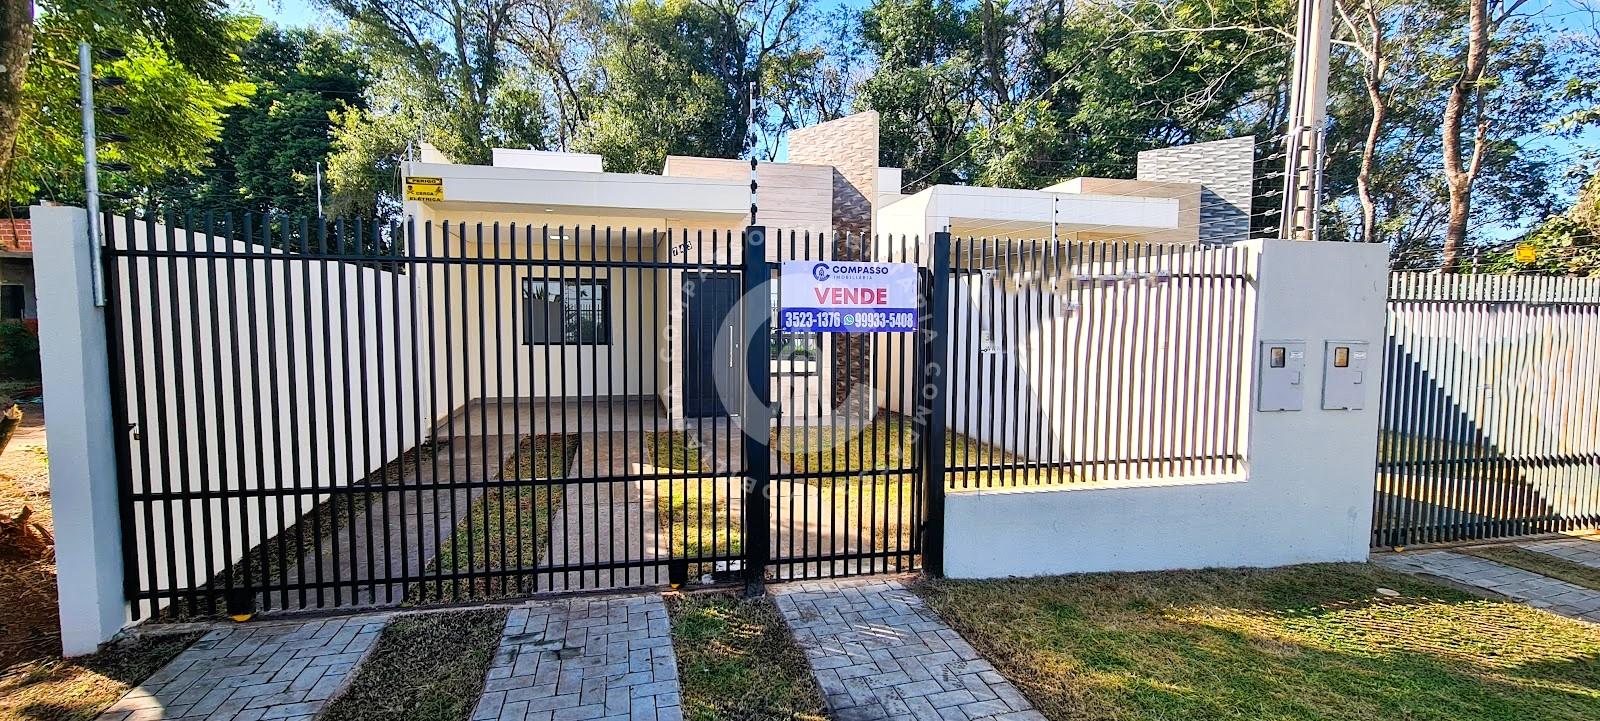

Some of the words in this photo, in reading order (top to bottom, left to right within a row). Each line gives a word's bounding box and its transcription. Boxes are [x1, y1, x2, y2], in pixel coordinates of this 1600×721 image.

[832, 265, 889, 275] COMPASSO
[814, 287, 887, 305] VENDE
[785, 311, 841, 328] 3523-1376
[854, 312, 914, 328] 99933-5408
